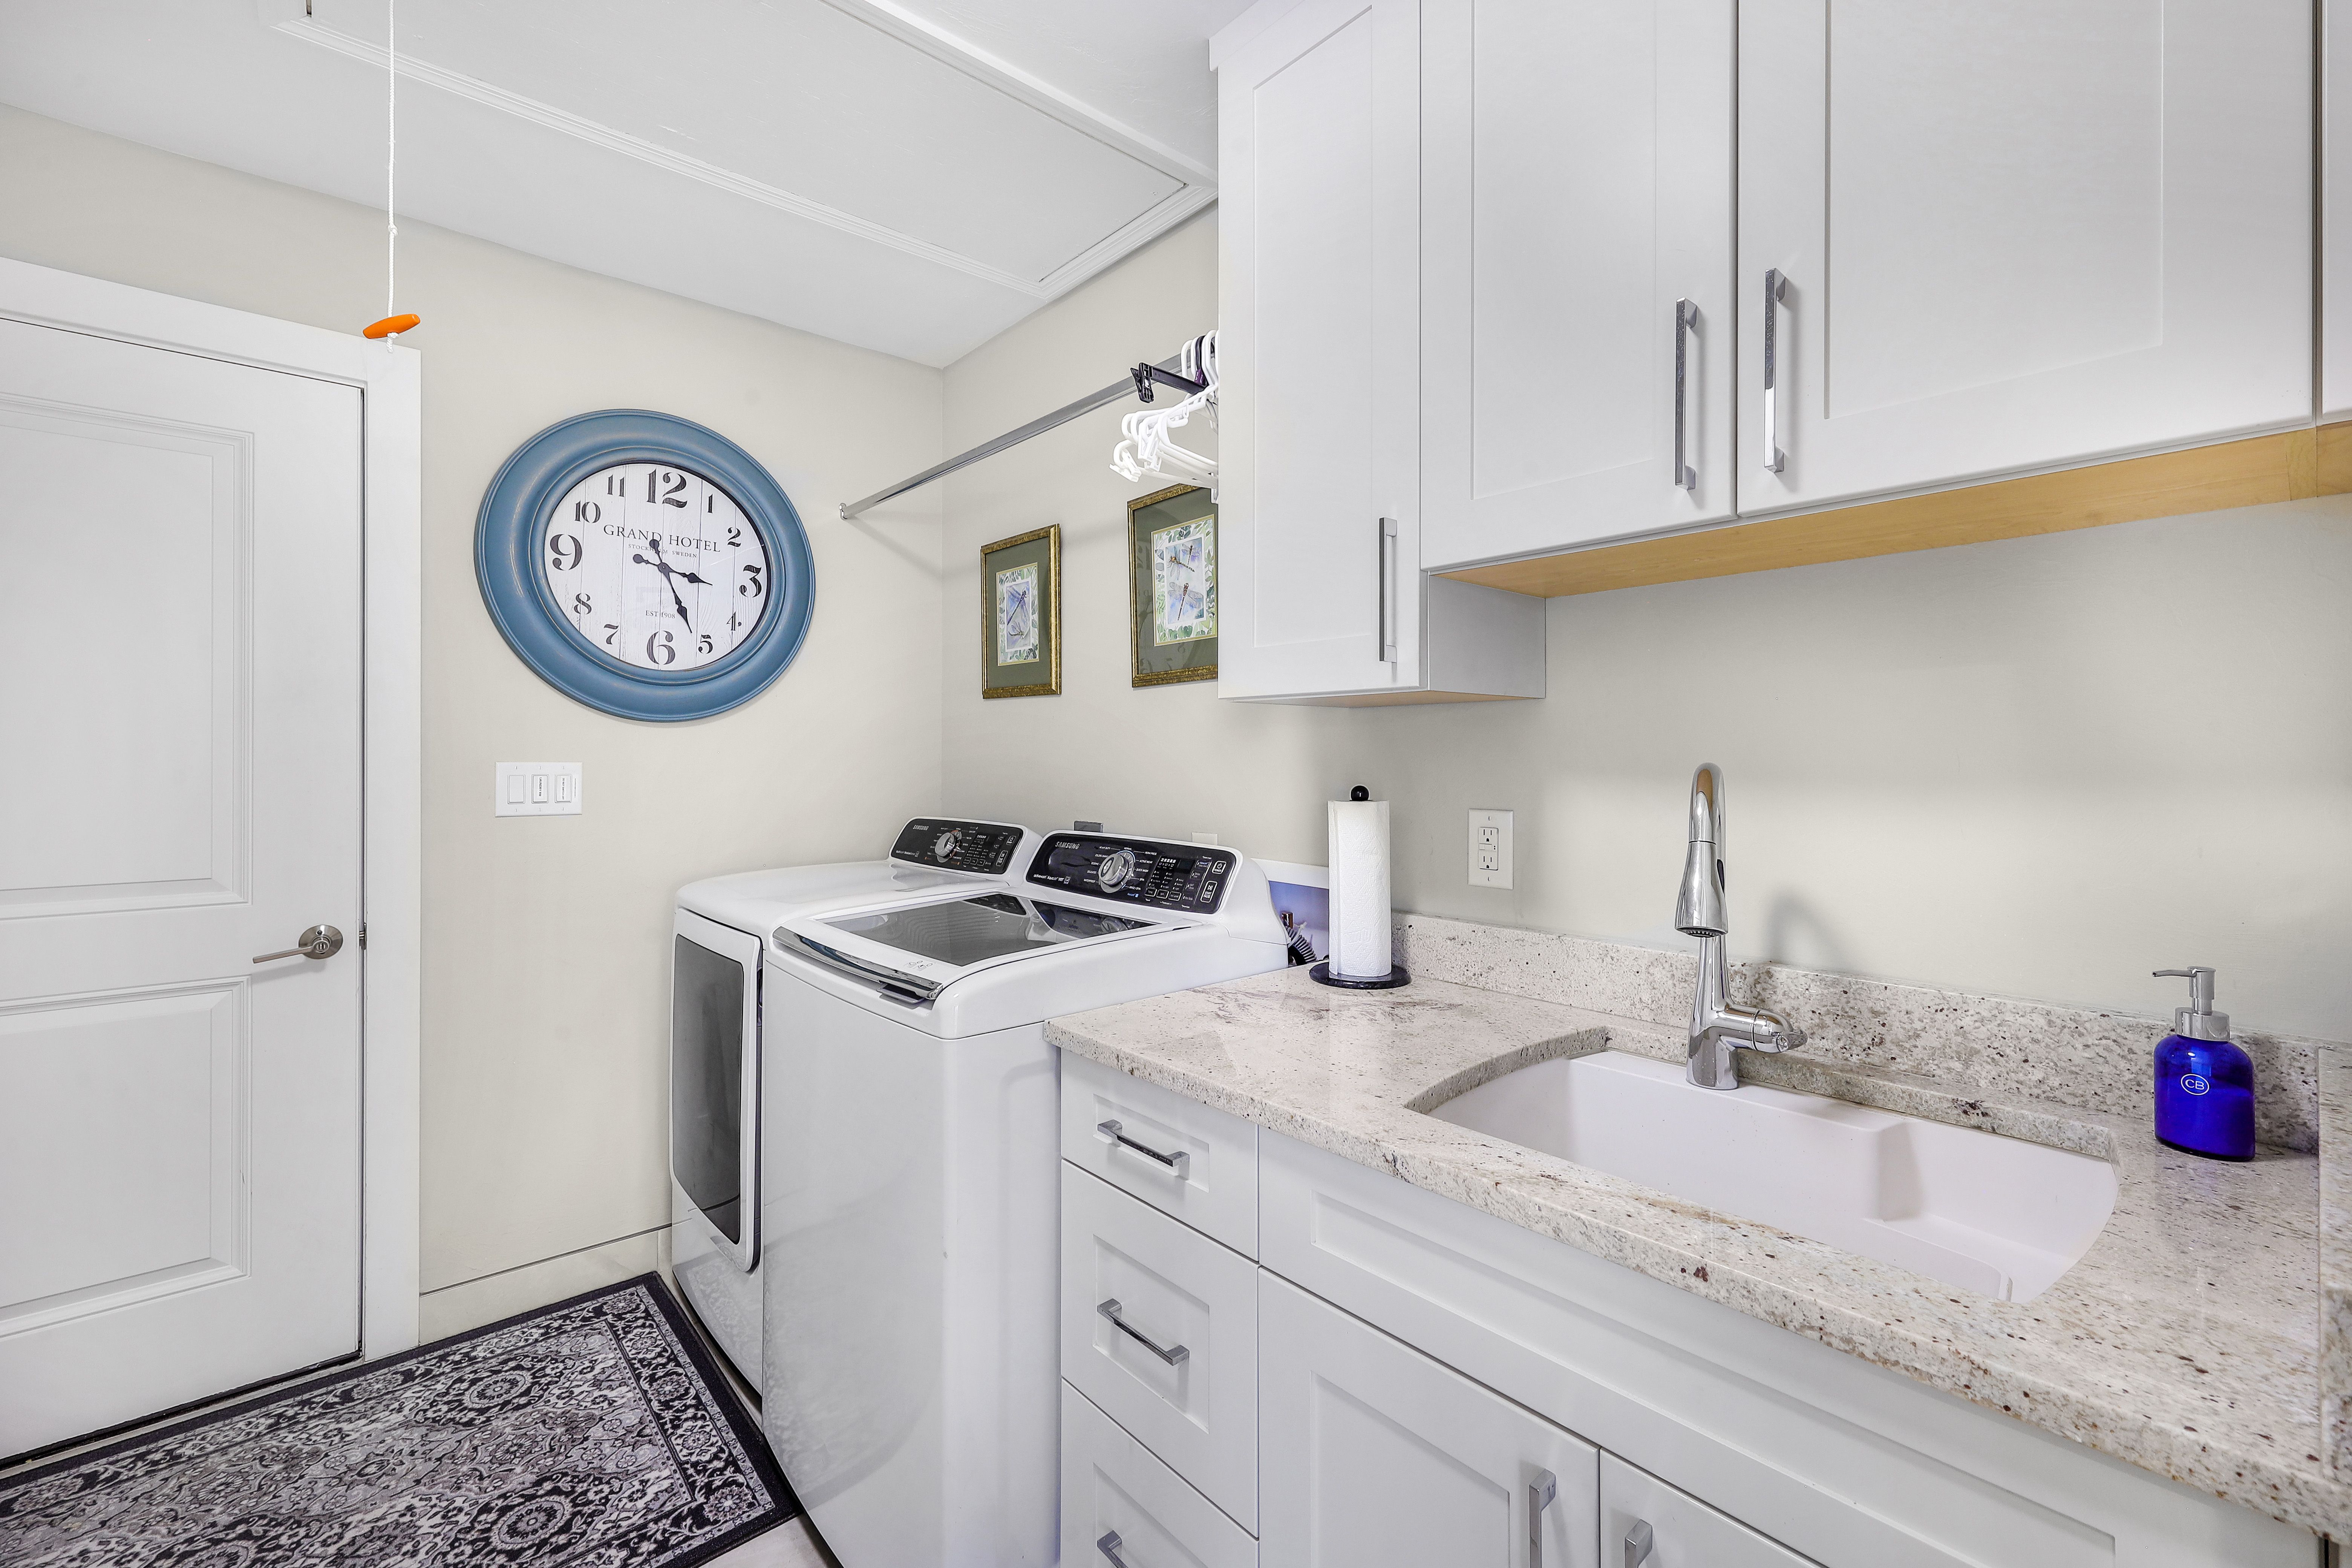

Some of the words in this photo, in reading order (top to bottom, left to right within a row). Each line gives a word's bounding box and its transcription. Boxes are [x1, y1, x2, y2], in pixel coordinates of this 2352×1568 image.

[607, 475, 625, 497] 11
[646, 469, 688, 508] 12
[574, 500, 601, 524] 10
[707, 494, 713, 514] 1
[603, 524, 662, 543] GRAND
[669, 534, 721, 553] HOTEL
[727, 527, 741, 547] 2
[550, 534, 582, 571] 9
[628, 544, 668, 554] STOCKHM
[739, 565, 762, 598] 3
[574, 593, 592, 615] 8
[726, 612, 742, 631] 4
[603, 624, 619, 645] 7
[698, 634, 713, 654] 5
[646, 630, 676, 665] 6
[1055, 841, 1080, 850] SAMSUNG
[2185, 1078, 2205, 1090] CB
